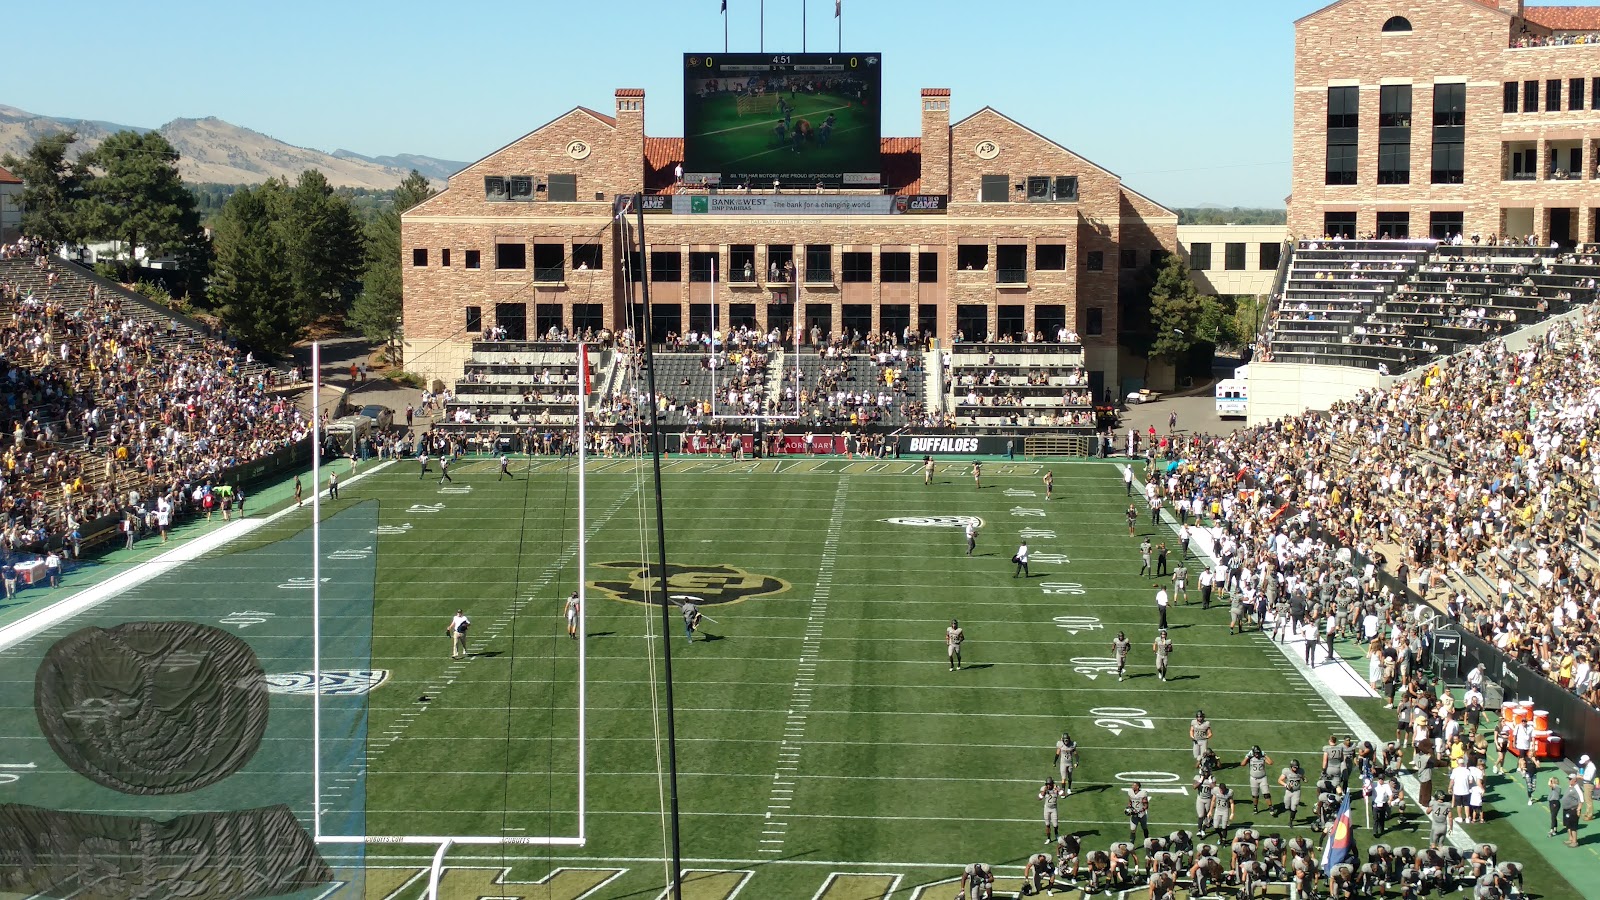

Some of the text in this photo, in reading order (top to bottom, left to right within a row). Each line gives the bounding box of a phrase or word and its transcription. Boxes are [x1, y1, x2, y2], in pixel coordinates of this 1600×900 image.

[705, 57, 713, 68] 0
[772, 55, 790, 64] 4:51
[850, 57, 858, 68] 0
[711, 198, 736, 206] BANK
[743, 198, 767, 206] WEST
[803, 201, 815, 209] for
[820, 201, 850, 210] changing
[911, 200, 939, 209] GAME
[909, 437, 979, 452] BUFFALOES
[1039, 582, 1087, 595] 50
[1052, 616, 1104, 631] 40
[1089, 707, 1155, 729] 20
[1251, 763, 1263, 771] 52
[1114, 771, 1189, 796] 10
[1434, 806, 1449, 816] 44
